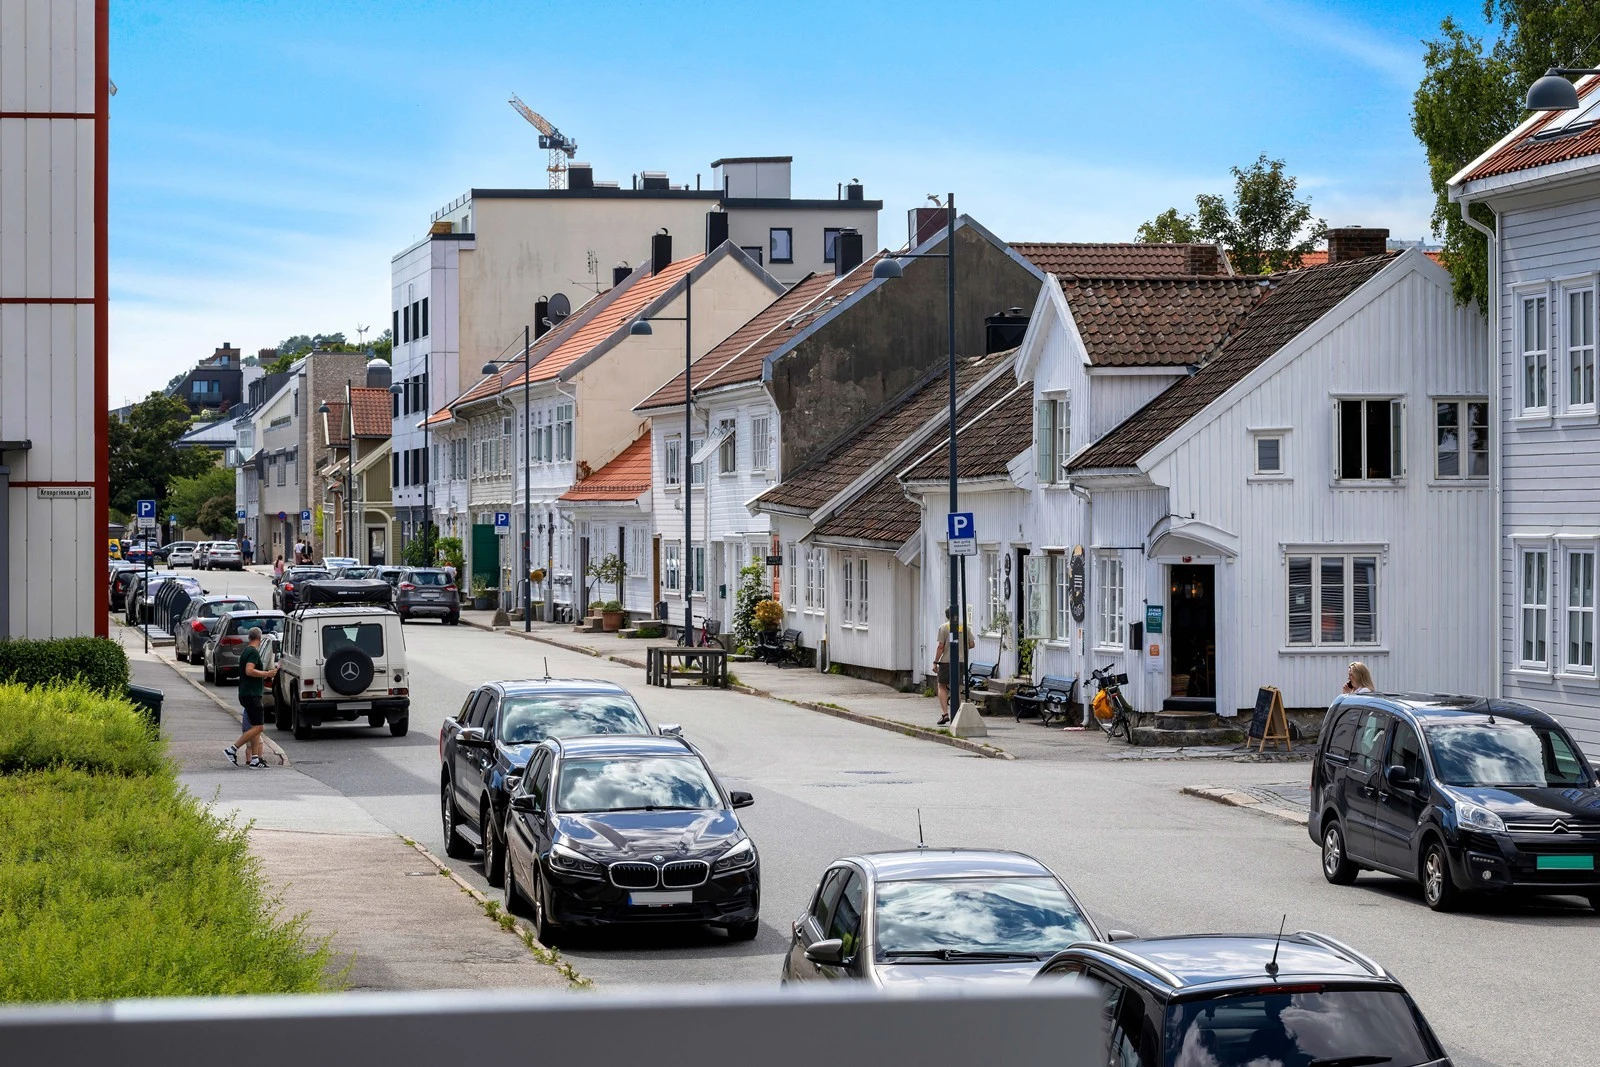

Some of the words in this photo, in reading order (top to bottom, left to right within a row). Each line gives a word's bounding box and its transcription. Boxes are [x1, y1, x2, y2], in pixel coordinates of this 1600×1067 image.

[141, 502, 152, 516] P
[302, 511, 309, 519] P
[498, 513, 506, 525] P
[953, 516, 968, 537] P
